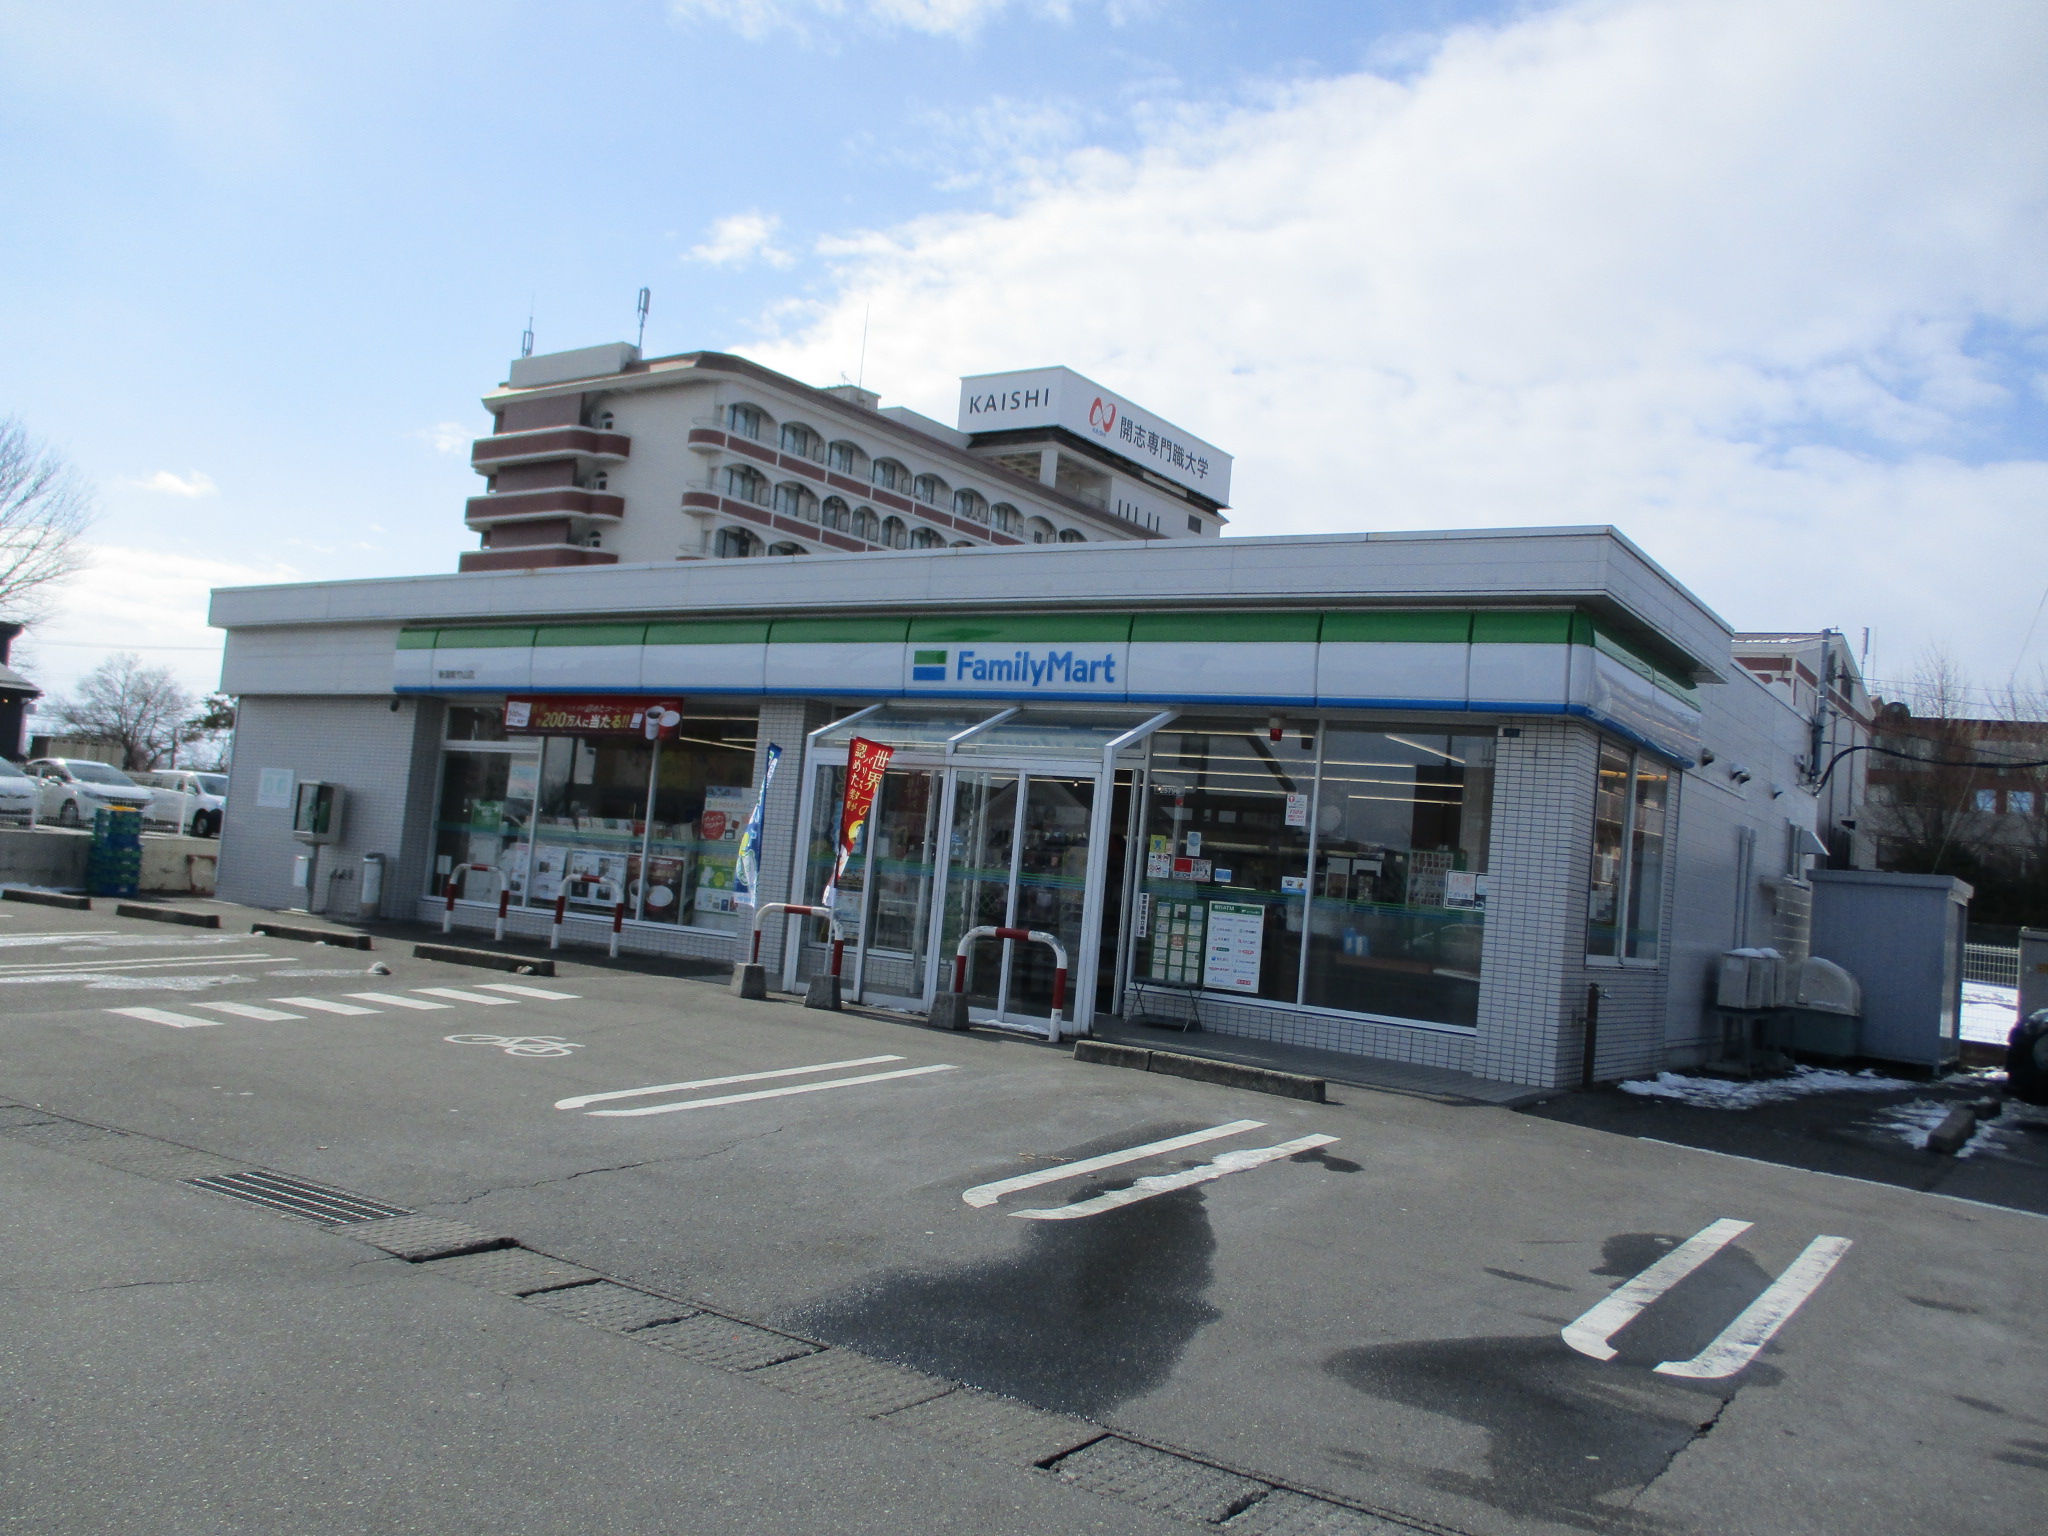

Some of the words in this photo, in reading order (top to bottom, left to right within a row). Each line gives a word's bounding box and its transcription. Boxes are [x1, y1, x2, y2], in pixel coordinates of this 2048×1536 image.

[969, 388, 1049, 414] KAISHI
[1119, 416, 1209, 480] 開志専門職大学
[957, 651, 1116, 686] FamilyMart
